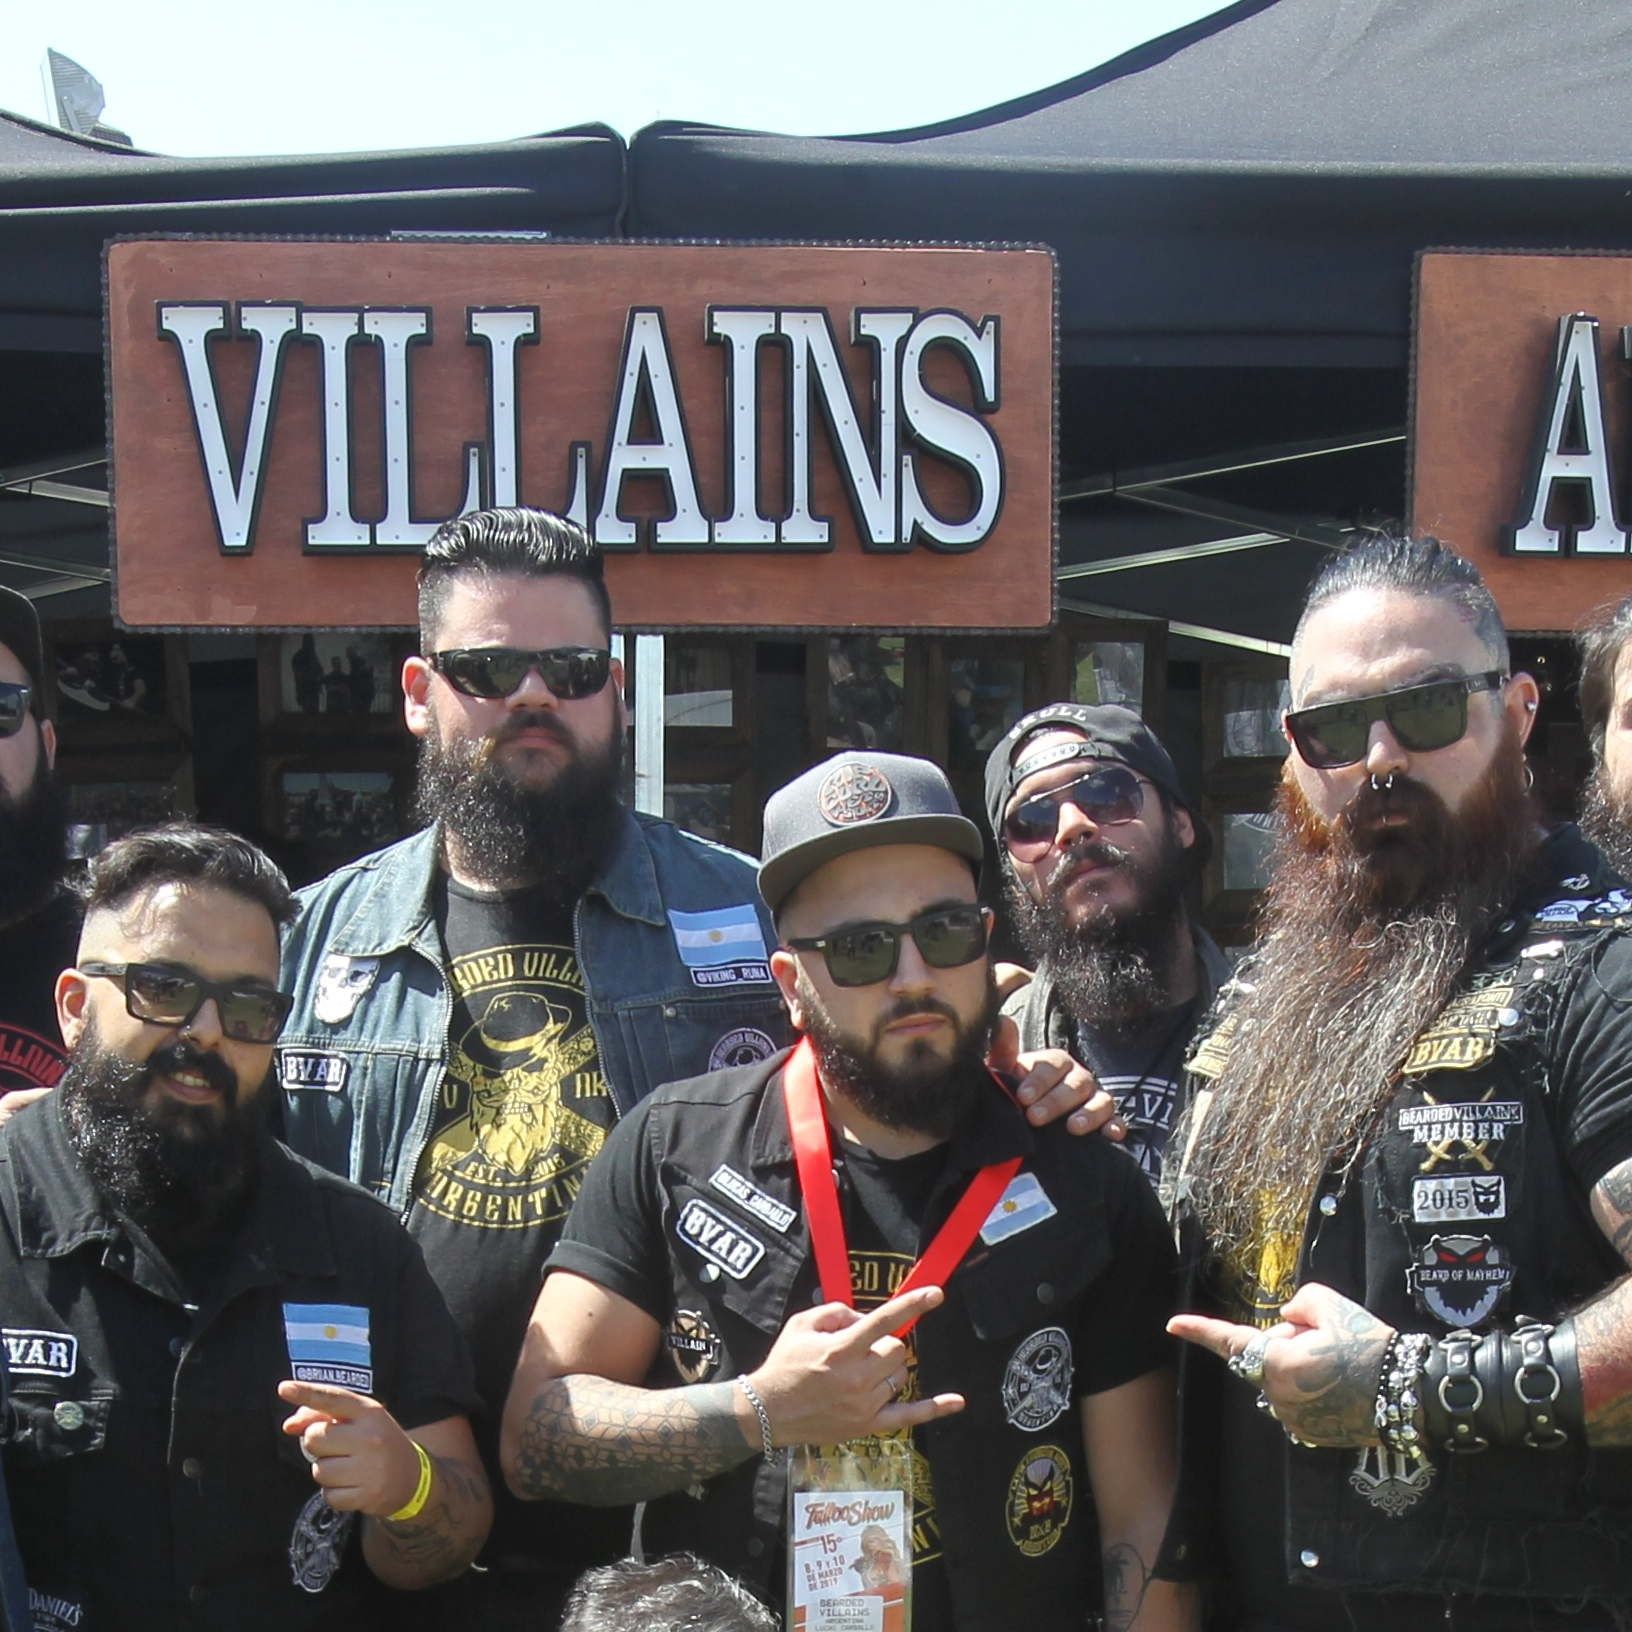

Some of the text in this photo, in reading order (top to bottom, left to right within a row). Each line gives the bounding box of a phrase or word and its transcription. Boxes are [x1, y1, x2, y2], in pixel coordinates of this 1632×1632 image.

[156, 300, 1006, 555] VILLAINS
[286, 1055, 343, 1081] BVAR
[1412, 1121, 1507, 1144] MEMBER
[429, 1166, 584, 1222] ARGENTIN
[1418, 1188, 1469, 1210] 2015
[684, 1207, 754, 1270] BVAR
[3, 1337, 69, 1369] VAR
[819, 1568, 844, 1580] MARZO
[819, 1598, 865, 1608] BEARDED
[819, 1608, 870, 1617] VILLAINS
